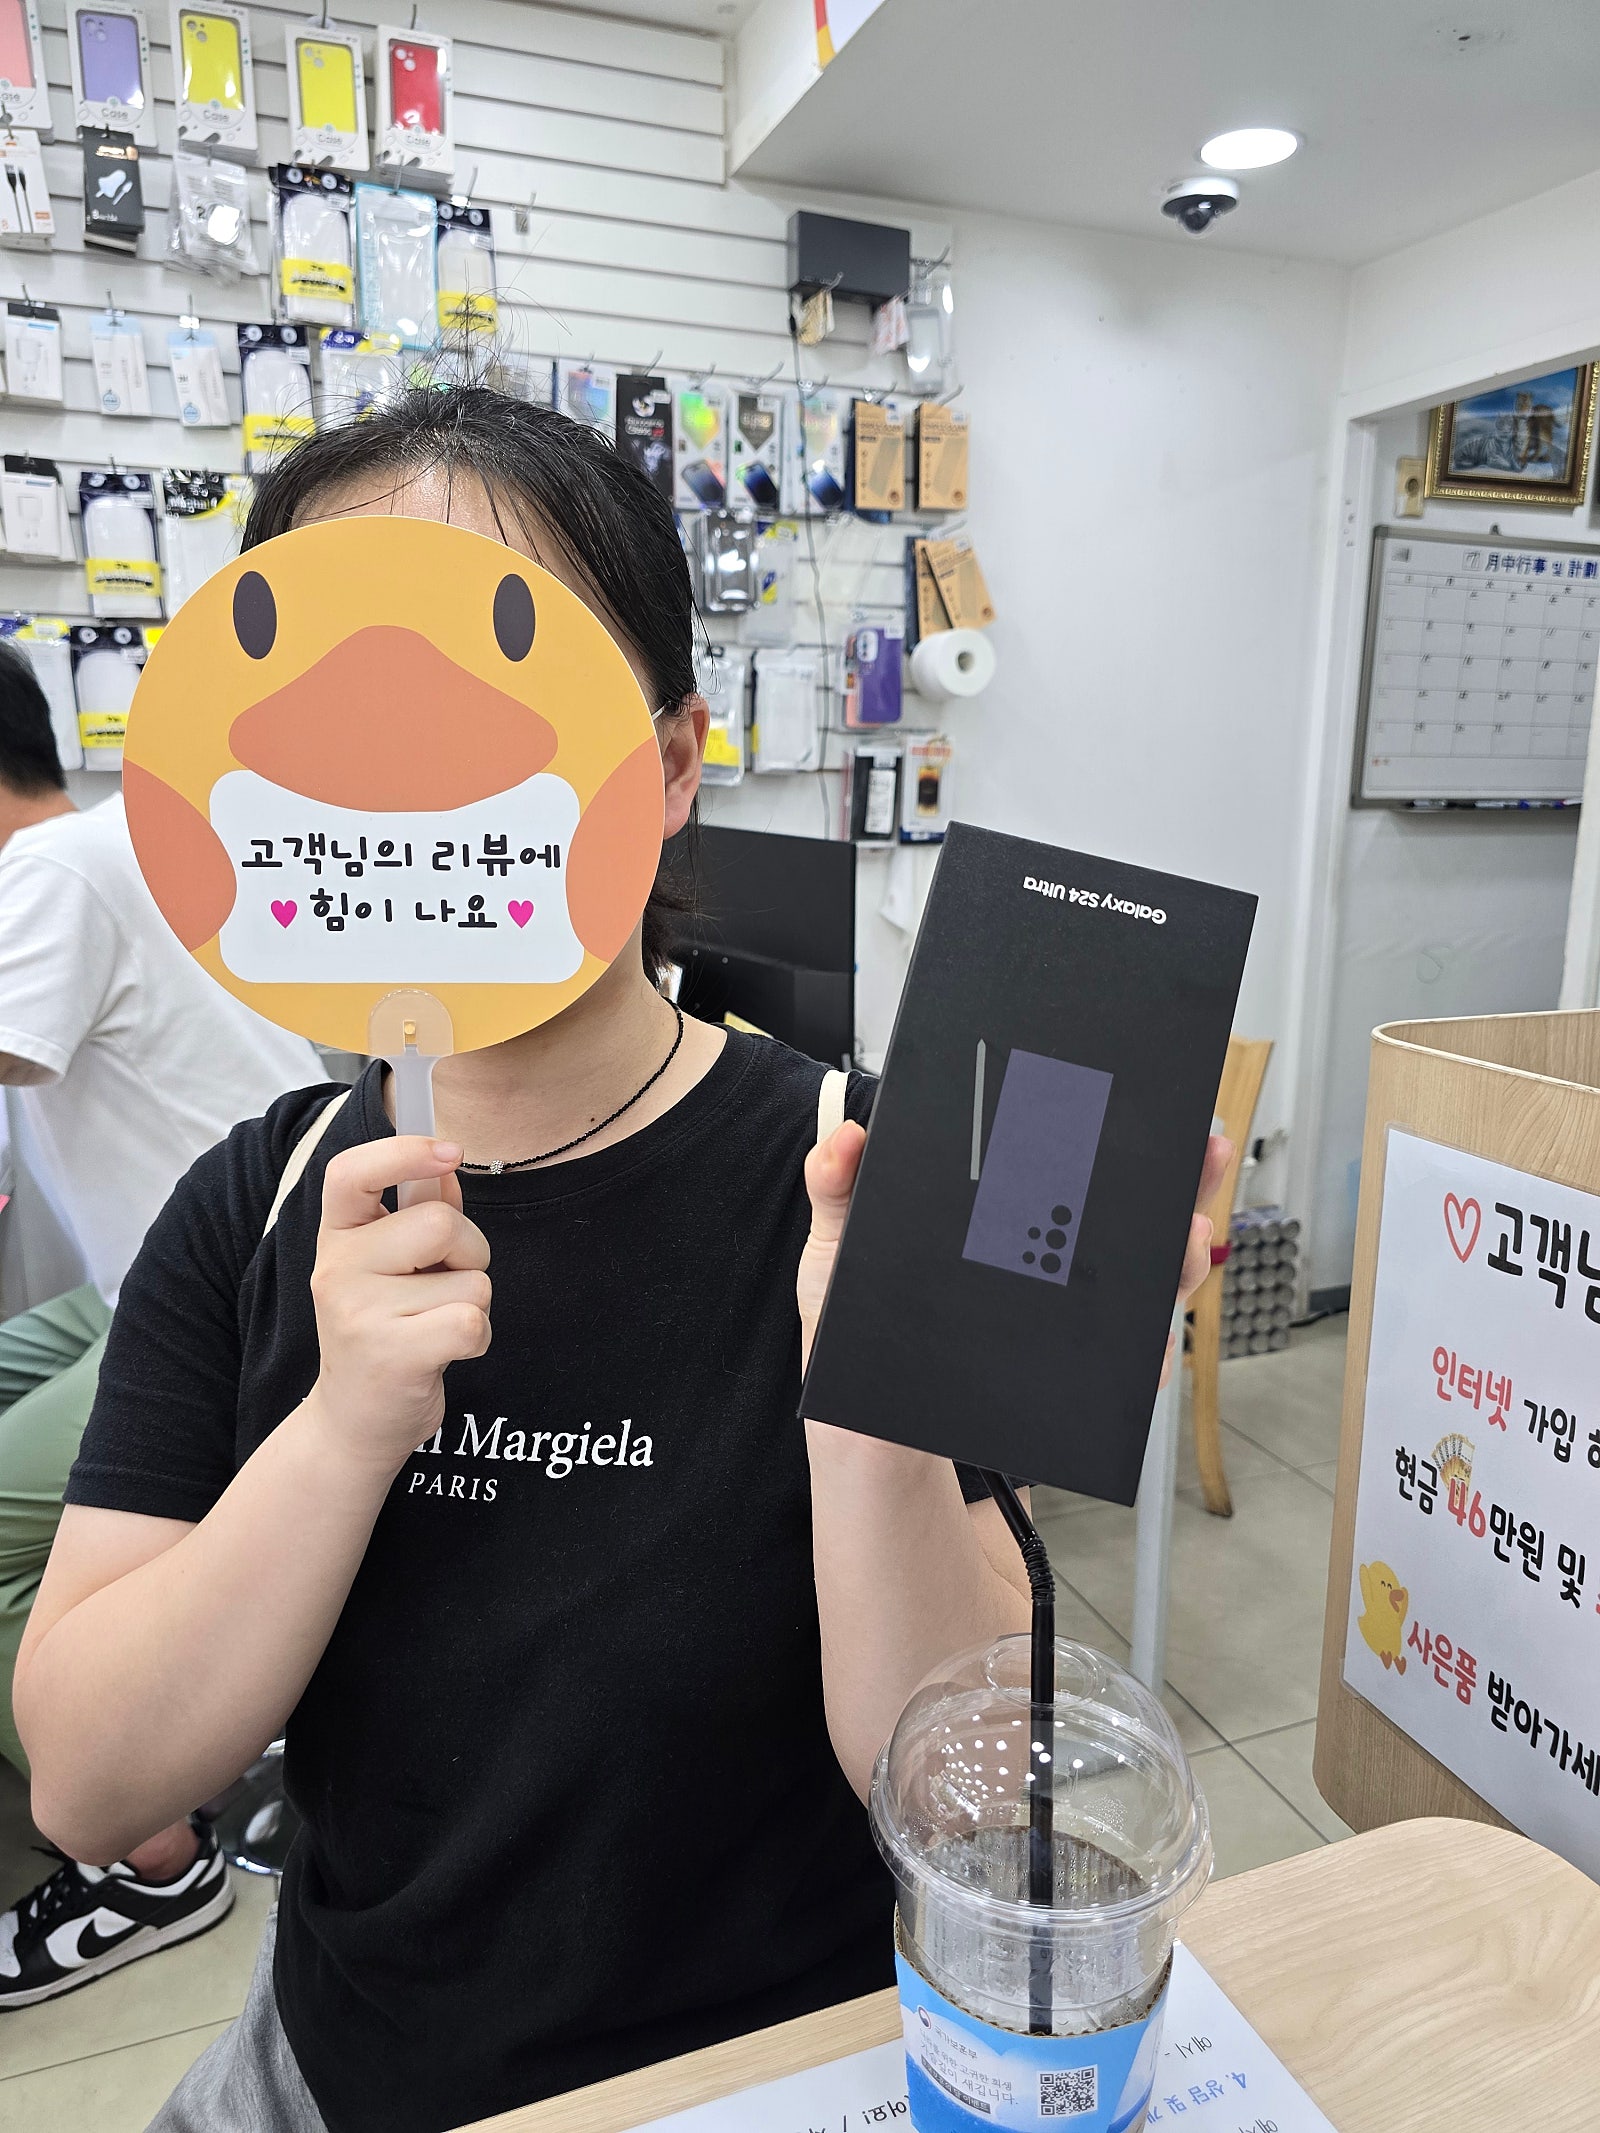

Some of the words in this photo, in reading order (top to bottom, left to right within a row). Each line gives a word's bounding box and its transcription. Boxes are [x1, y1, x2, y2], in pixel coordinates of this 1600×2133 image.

[0, 92, 20, 101] ase
[101, 108, 129, 120] Case
[203, 110, 230, 122] Case
[241, 832, 413, 877] 고객님의
[432, 833, 561, 877] 리뷰에
[1023, 876, 1066, 901] Ultra
[1068, 887, 1100, 908] S24
[310, 888, 393, 931] 힘이
[415, 895, 497, 929] 나요
[1101, 893, 1167, 925] Galaxy
[1432, 1346, 1513, 1432] 인터넷
[1524, 1398, 1577, 1463] 가입
[454, 1413, 654, 1479] Margiela
[408, 1472, 498, 1502] PARIS
[1395, 1446, 1438, 1514] 현금
[1447, 1478, 1544, 1582] 46만원
[1557, 1544, 1586, 1608] 및
[1407, 1621, 1479, 1705] 사은품
[935, 2026, 977, 2059] 국가보훈부
[1175, 2036, 1213, 2059] 예시
[959, 2064, 989, 2084] 고귀한
[991, 2078, 1012, 2091] 희생
[1225, 2071, 1247, 2089] 4.
[962, 2079, 1019, 2105] 새깁니다.
[1163, 2094, 1188, 2115] 및
[1187, 2079, 1225, 2106] 상담
